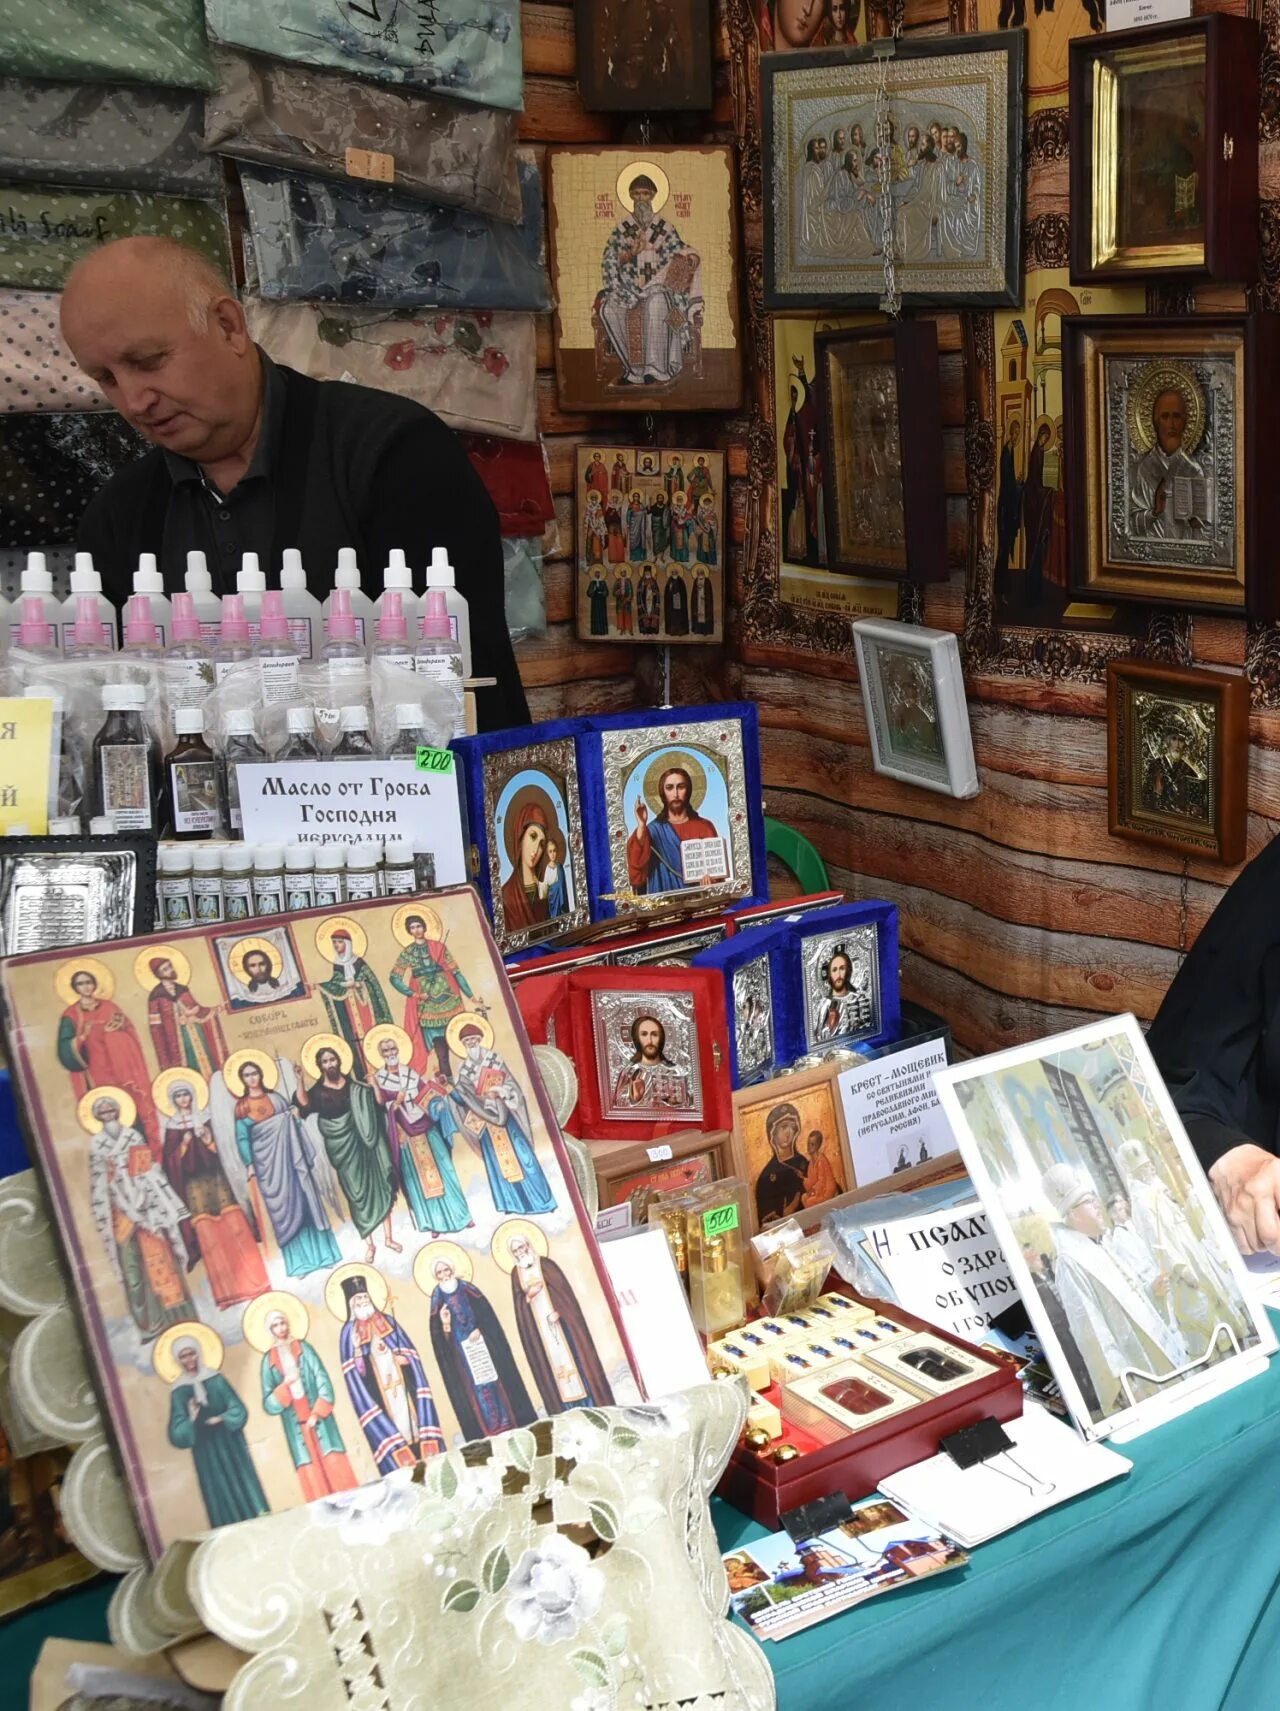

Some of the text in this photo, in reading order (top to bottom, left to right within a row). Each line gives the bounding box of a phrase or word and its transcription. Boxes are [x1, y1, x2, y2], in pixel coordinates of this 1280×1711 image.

[420, 750, 451, 771] 200
[261, 777, 431, 802] Масло от Гроба
[300, 804, 397, 827] Господня
[851, 1075, 882, 1095] КРЕСТ
[891, 1053, 945, 1080] МОЩЕВИК
[866, 1092, 875, 1100] СО
[876, 1073, 925, 1097] СВЯТЫНЯМИ
[862, 1095, 920, 1124] ПРАВОСЛАВНОГО
[890, 1116, 921, 1134] РОССИЯ)
[709, 1207, 733, 1229] 500
[908, 1214, 988, 1251] ПСАЛ
[942, 1262, 954, 1276] О
[936, 1290, 963, 1309] ОБ
